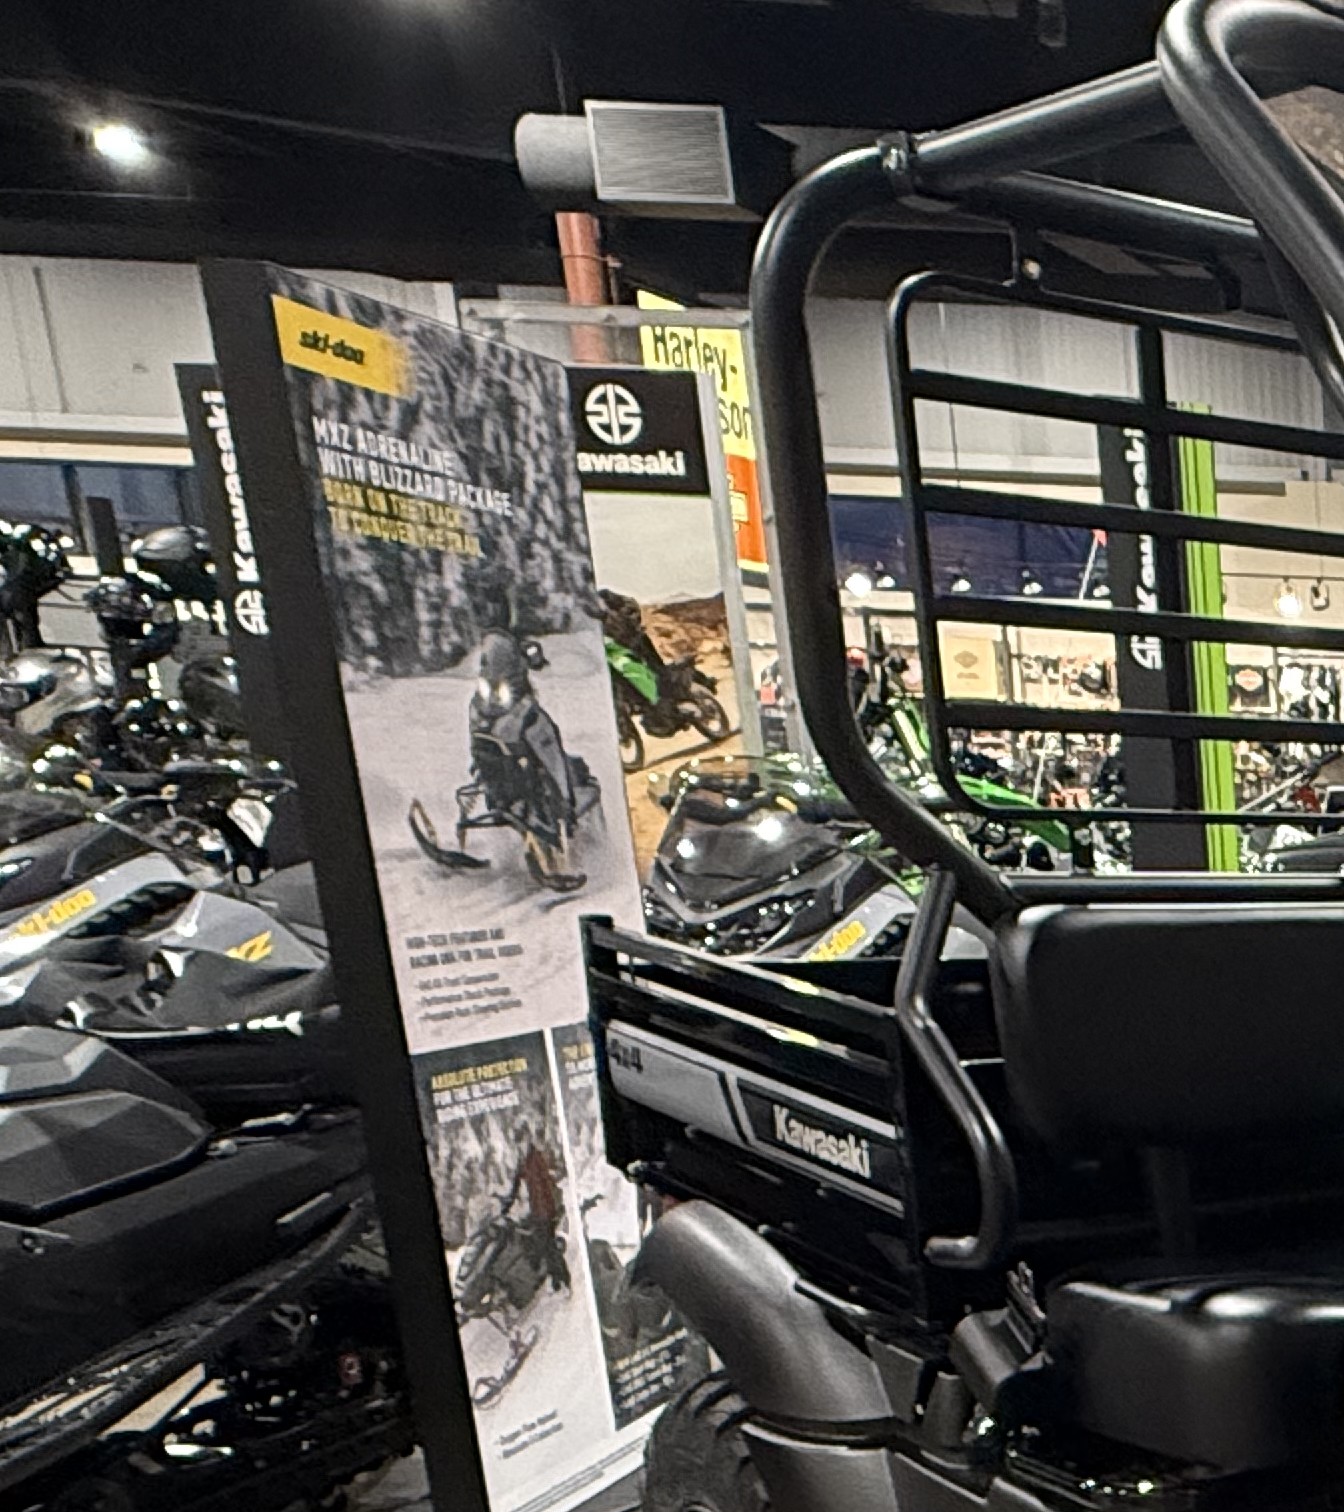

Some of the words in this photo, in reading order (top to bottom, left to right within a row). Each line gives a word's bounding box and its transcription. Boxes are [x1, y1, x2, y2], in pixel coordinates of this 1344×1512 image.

[300, 330, 365, 364] ski-doo
[652, 324, 738, 392] Harley-
[312, 414, 353, 451] MXZ
[718, 397, 752, 440] son
[202, 390, 261, 582] Kawasaki
[317, 447, 367, 483] WITH
[369, 458, 446, 500] BLIZZARD
[577, 450, 687, 477] awasaki
[1122, 428, 1158, 612] Kawsaki
[772, 1104, 870, 1179] Kawasaki
